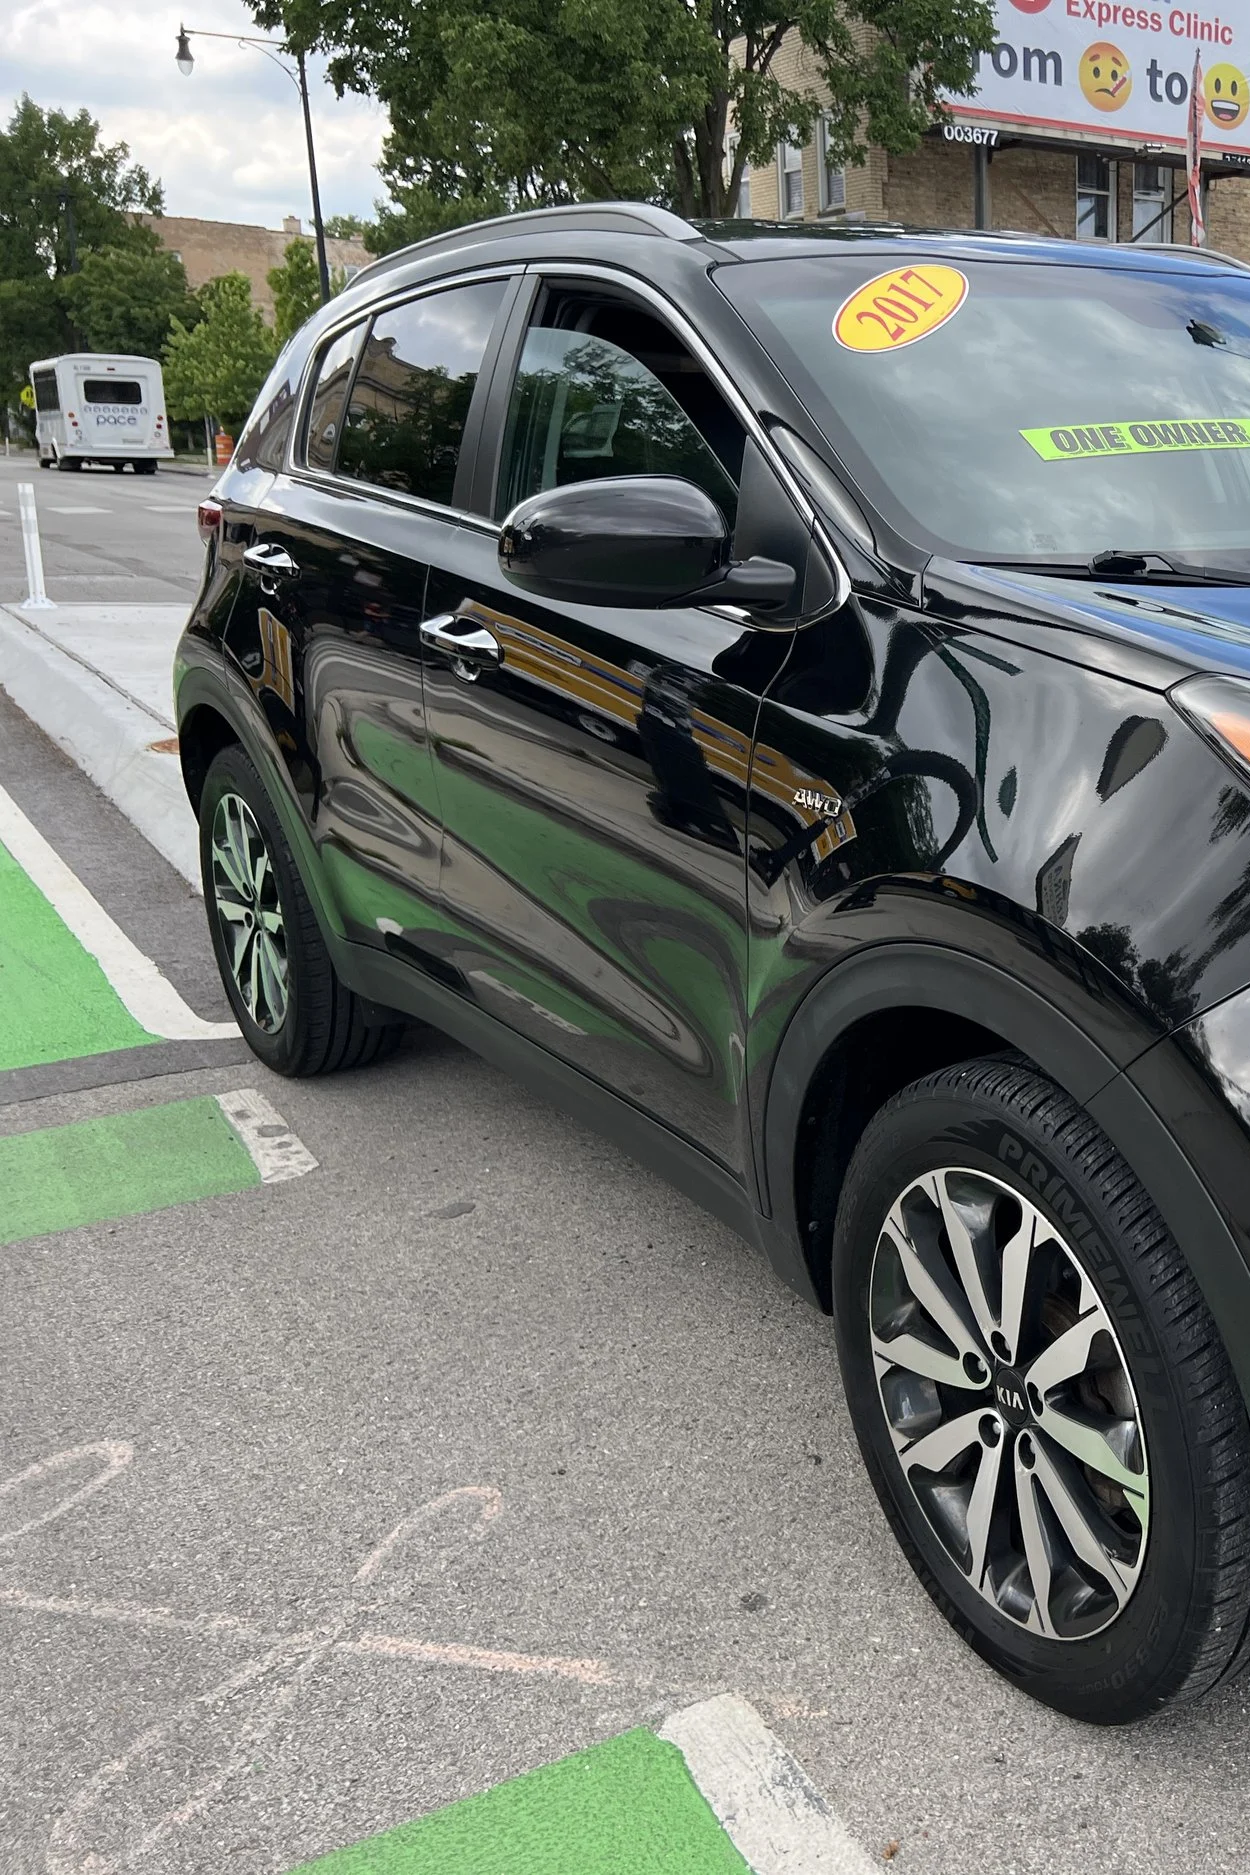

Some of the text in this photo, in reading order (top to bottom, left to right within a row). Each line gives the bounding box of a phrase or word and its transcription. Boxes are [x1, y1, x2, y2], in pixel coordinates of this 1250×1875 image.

[1066, 0, 1233, 46] Express Clinic
[1146, 58, 1189, 105] to
[943, 125, 998, 146] 003677
[855, 269, 943, 342] 2017
[96, 414, 137, 427] pace
[1049, 426, 1131, 454] ONE
[792, 787, 842, 817] AWD
[998, 1132, 1170, 1413] PRIMEWELL
[996, 1384, 1025, 1410] KIA
